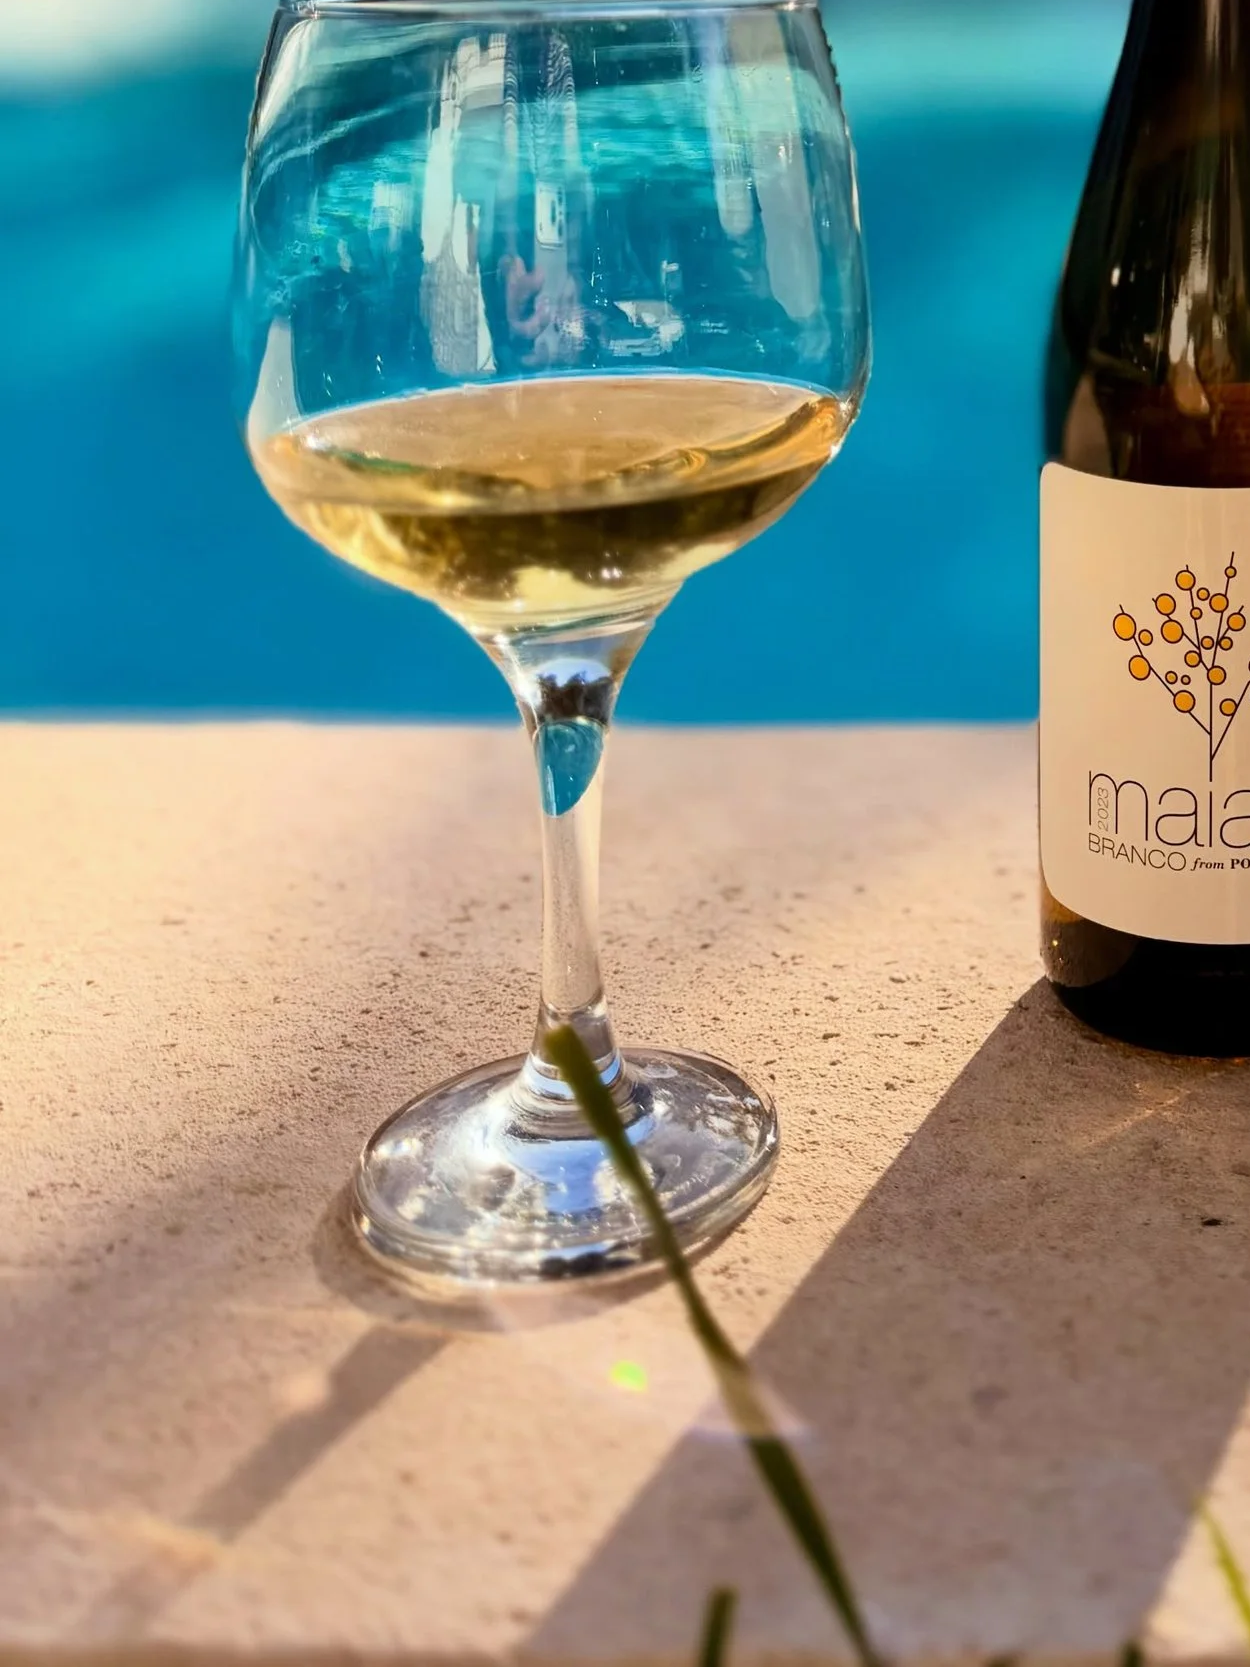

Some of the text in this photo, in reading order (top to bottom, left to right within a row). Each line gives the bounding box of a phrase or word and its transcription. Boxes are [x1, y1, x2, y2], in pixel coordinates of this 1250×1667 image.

[1097, 787, 1109, 832] 2023
[1088, 832, 1187, 871] BRANCO
[1190, 857, 1225, 871] from
